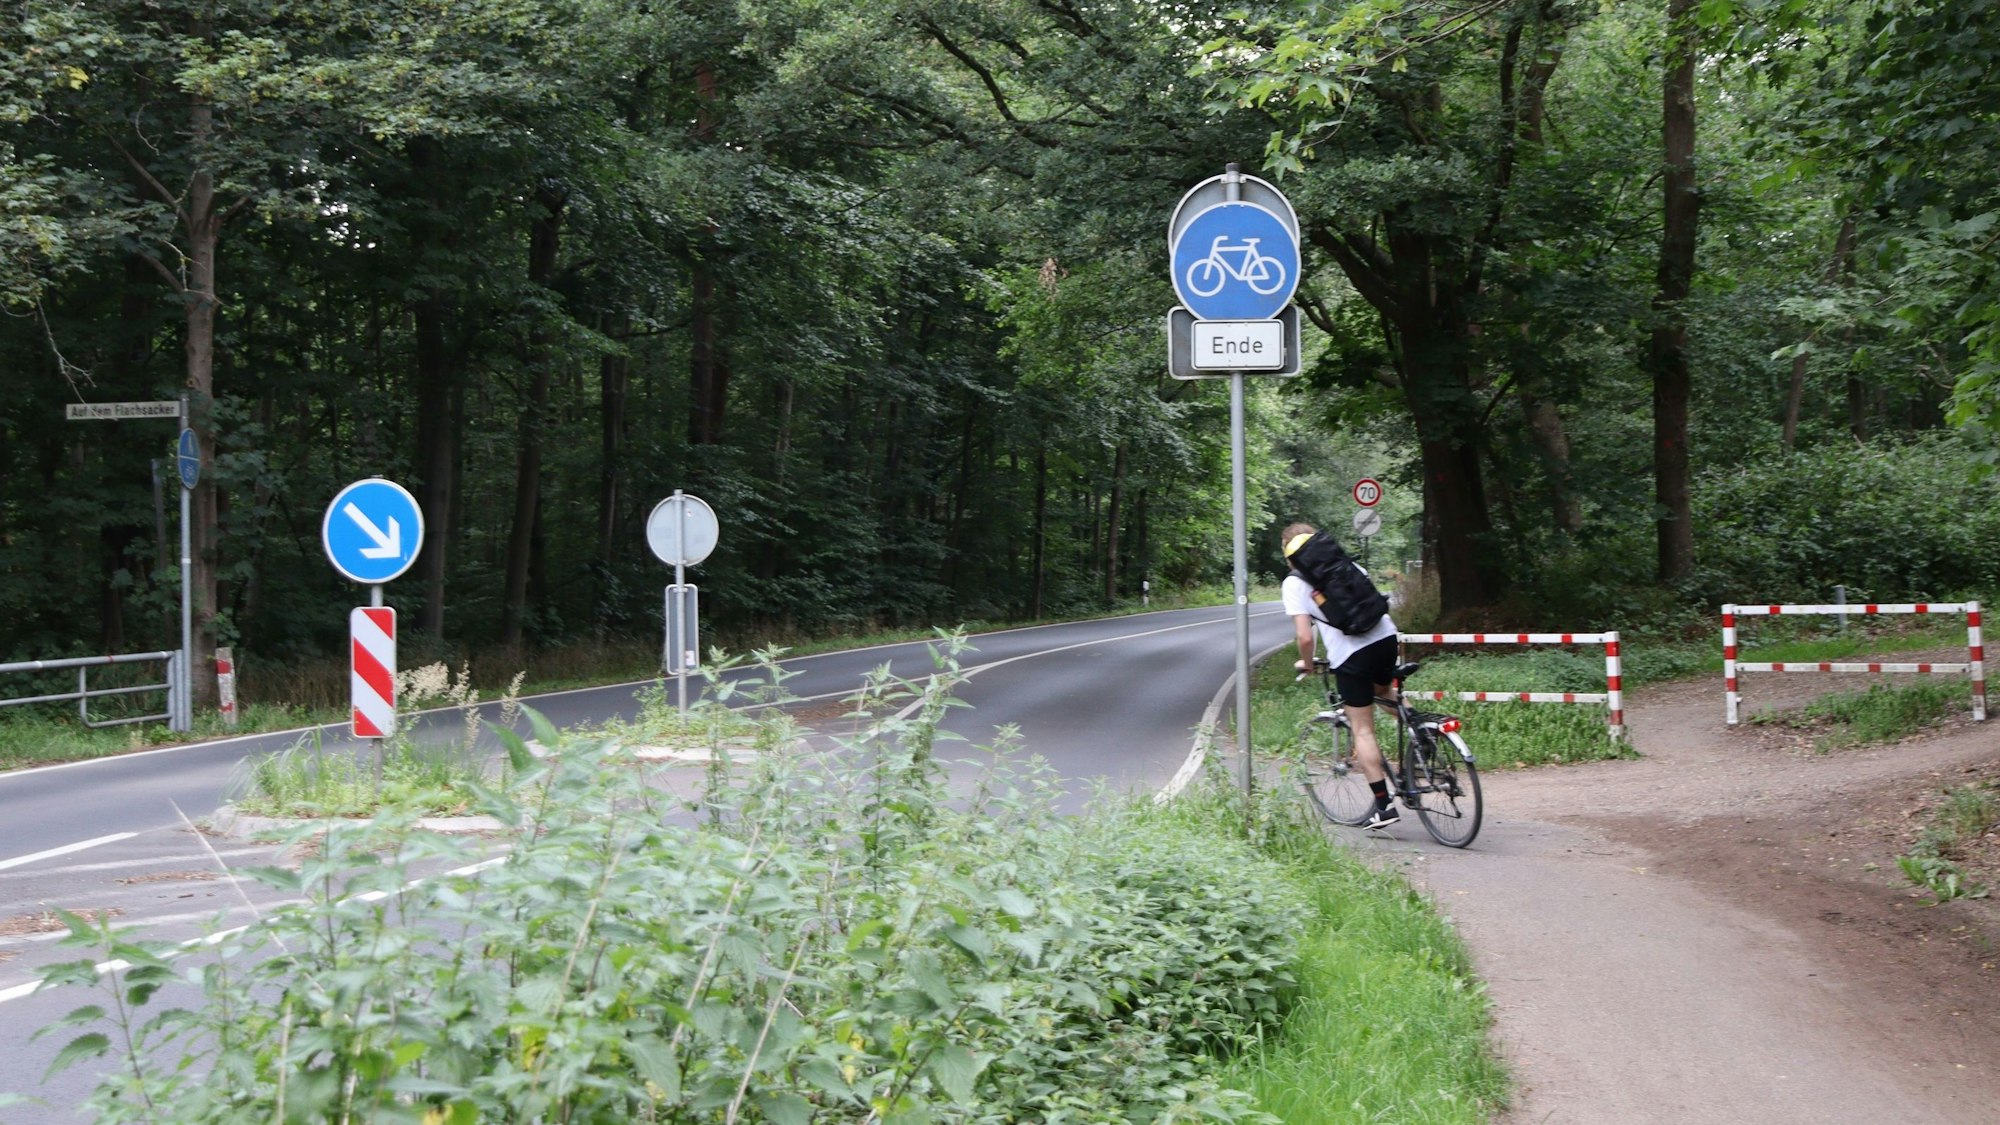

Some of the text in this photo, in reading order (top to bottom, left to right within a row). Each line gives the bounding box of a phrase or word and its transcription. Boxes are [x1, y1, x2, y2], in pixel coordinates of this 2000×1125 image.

[1212, 336, 1263, 354] Ende
[71, 405, 88, 417] Auf
[115, 404, 175, 415] Flachsacker
[1360, 486, 1376, 500] 70
